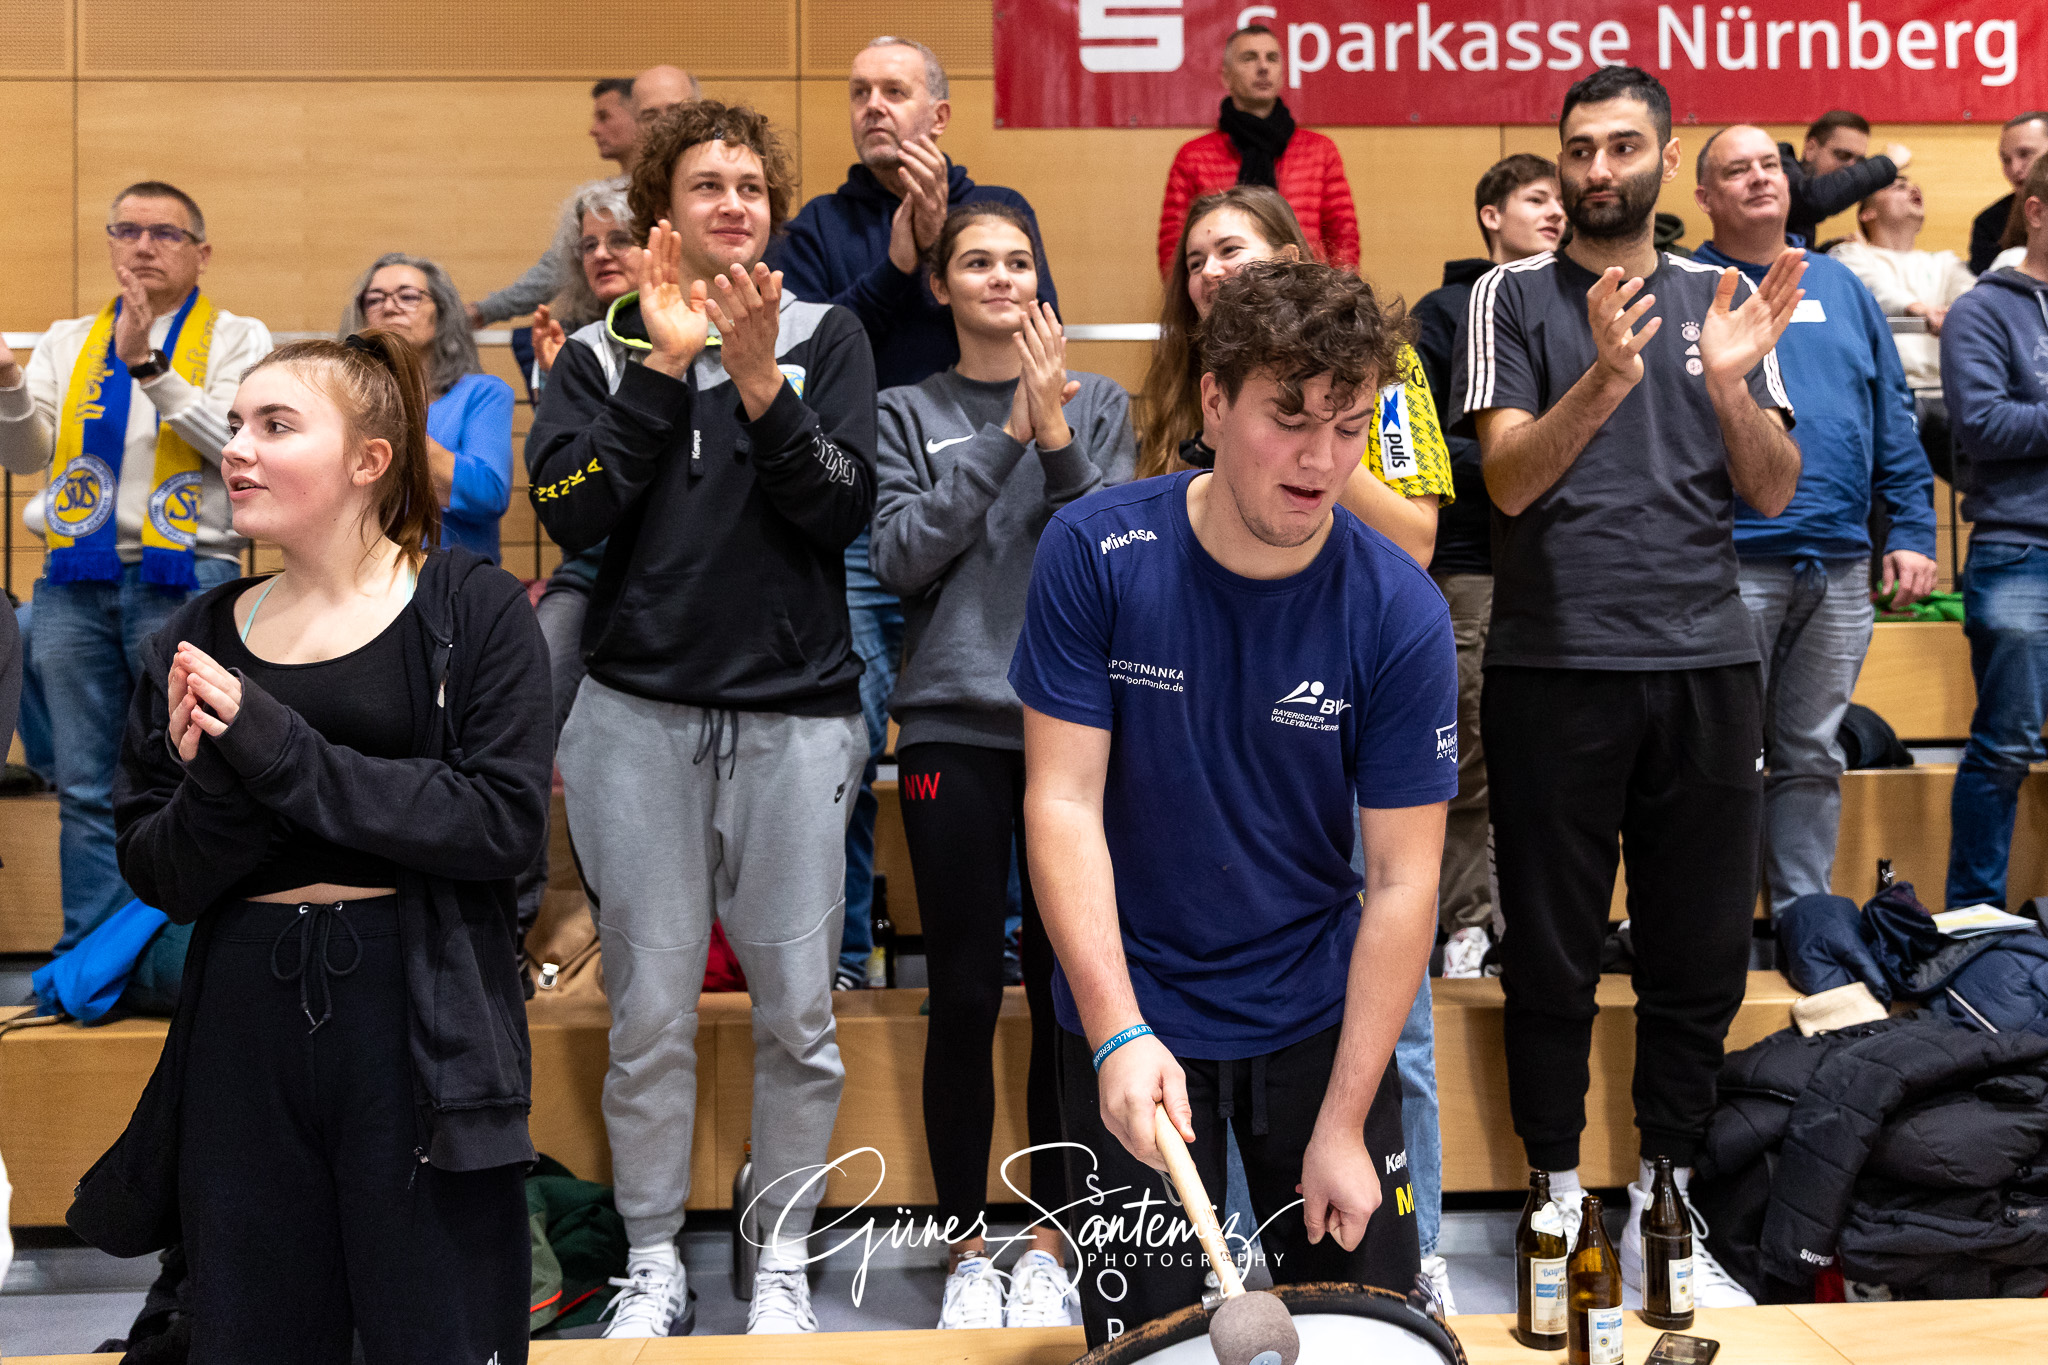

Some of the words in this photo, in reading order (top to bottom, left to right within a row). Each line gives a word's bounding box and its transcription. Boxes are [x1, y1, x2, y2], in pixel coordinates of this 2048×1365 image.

[1657, 1, 2018, 87] Nürnberg
[1383, 433, 1411, 468] puls
[1272, 708, 1325, 723] BAYERISCHER
[904, 771, 941, 800] NW
